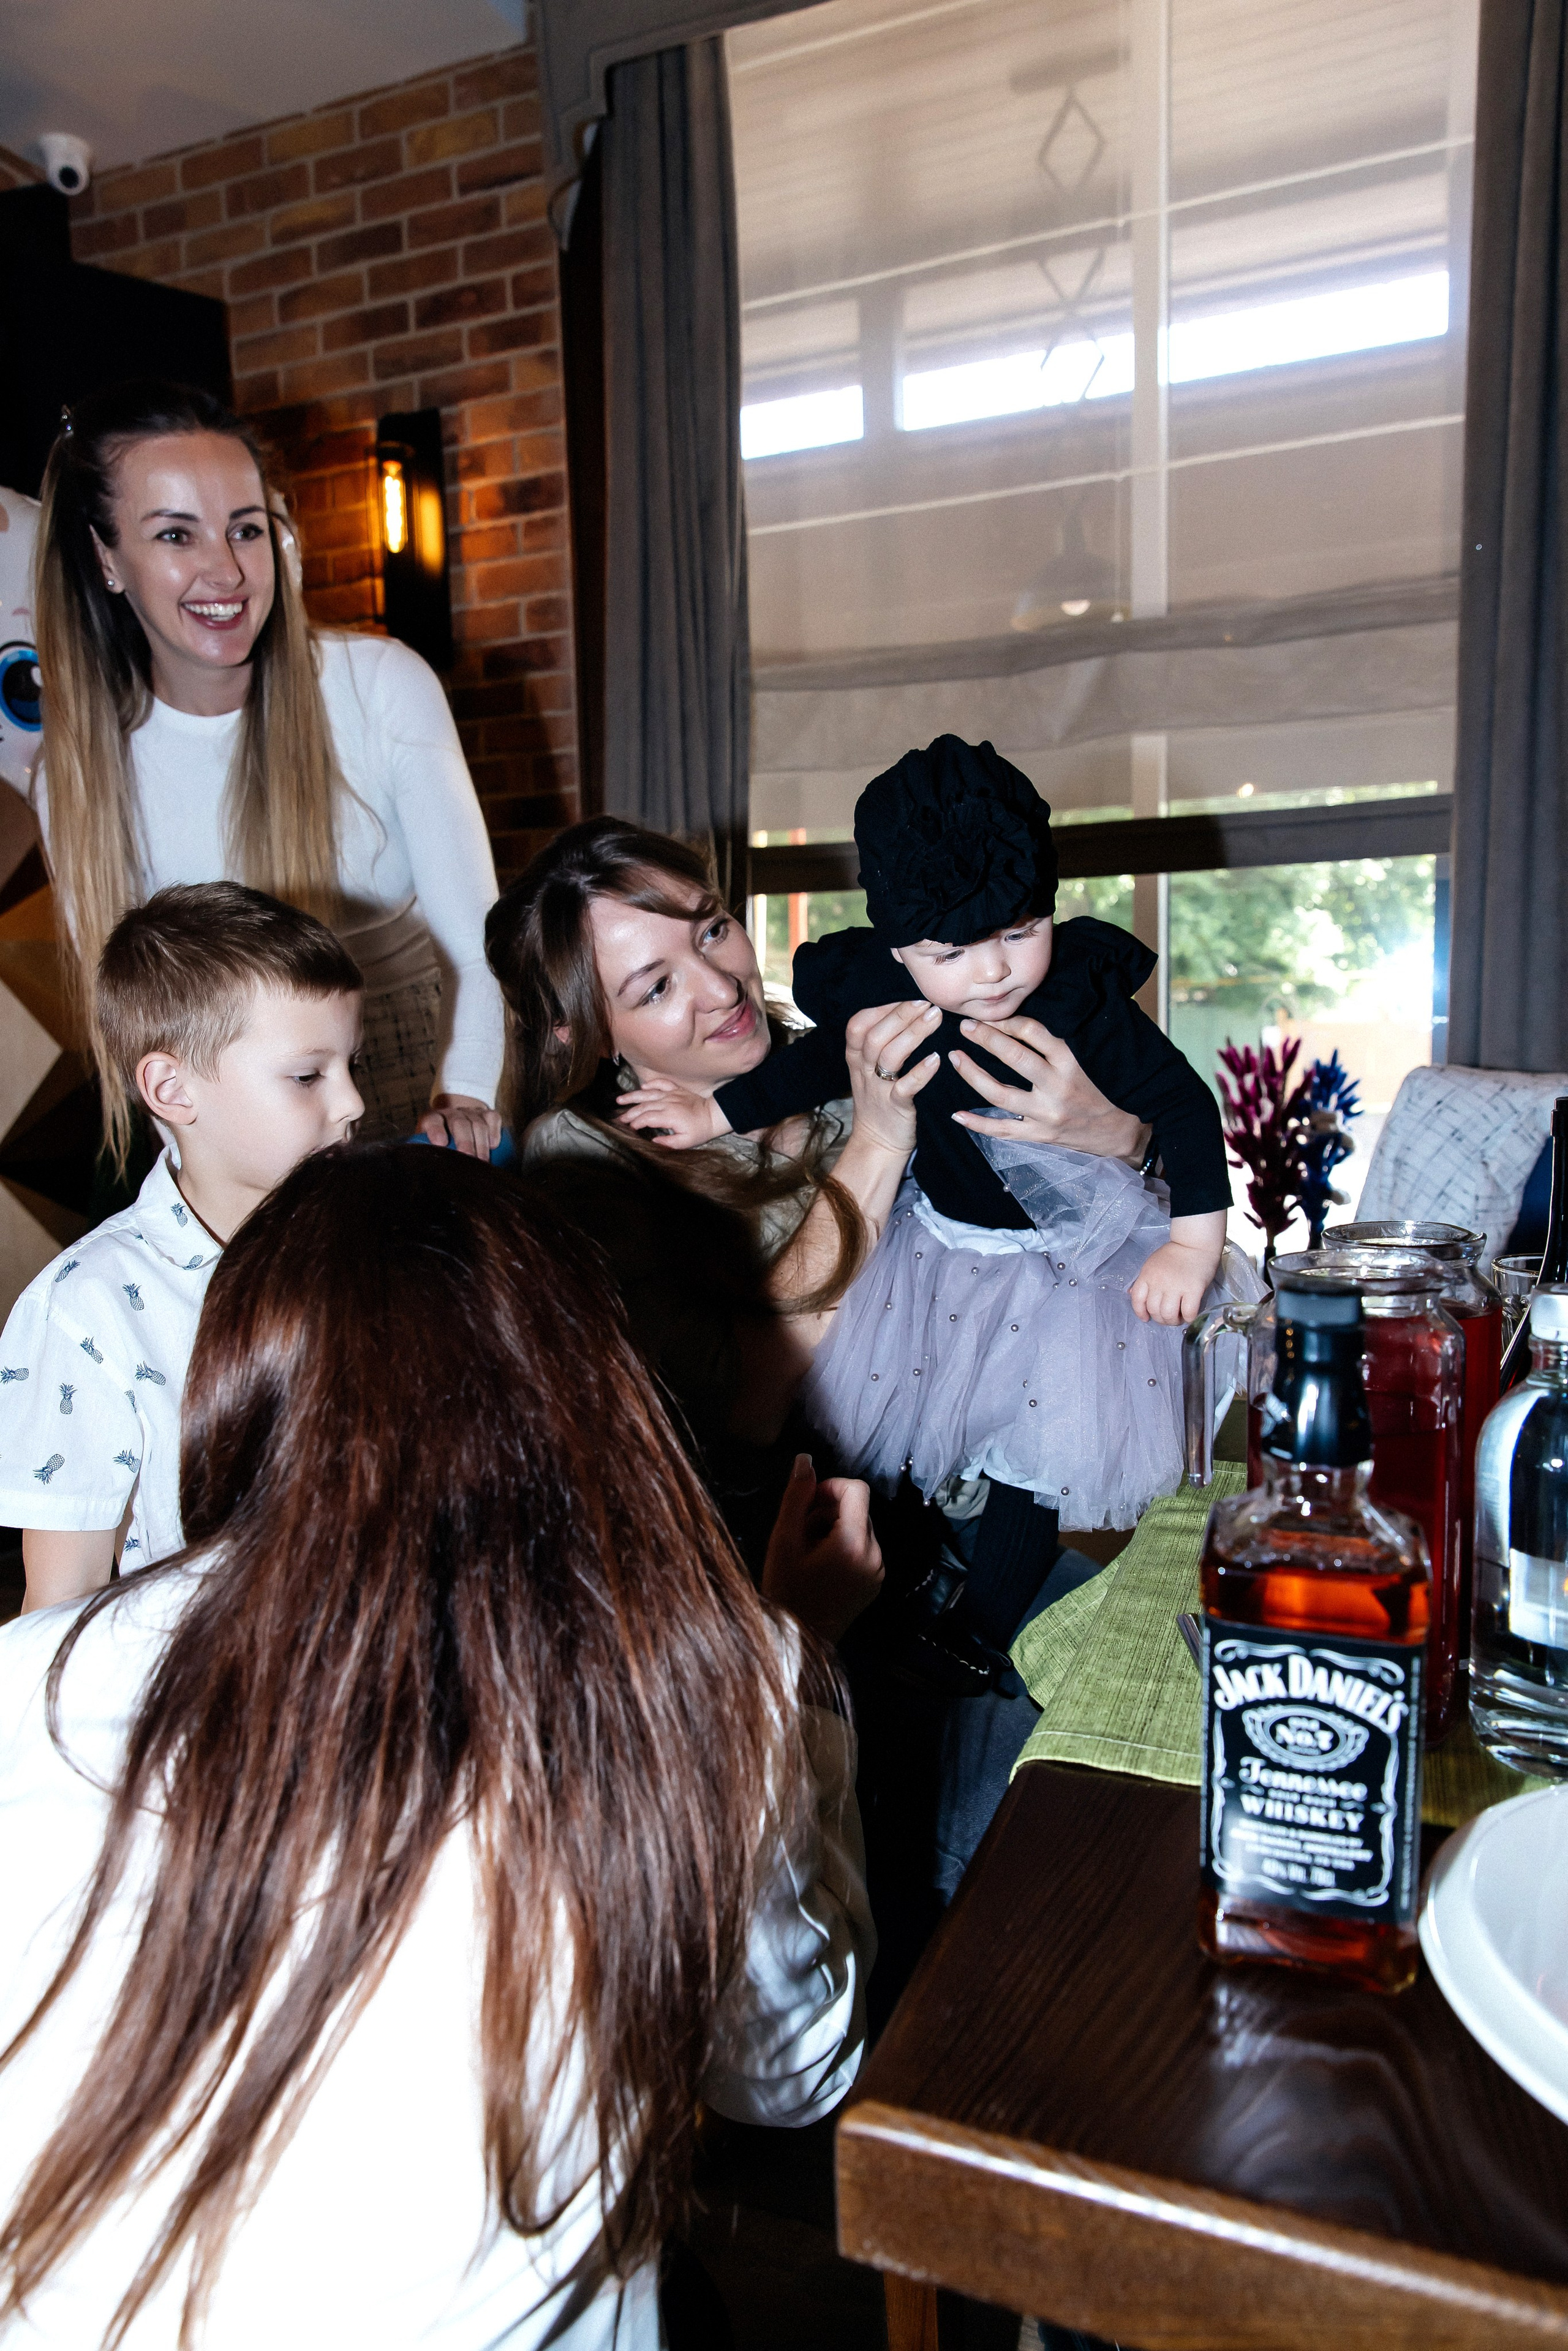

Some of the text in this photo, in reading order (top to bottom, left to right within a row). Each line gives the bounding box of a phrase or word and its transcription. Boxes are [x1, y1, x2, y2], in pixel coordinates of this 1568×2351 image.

[1213, 1654, 1409, 1734] JACK DANIEL'S
[1240, 1794, 1365, 1832] WHISKEY
